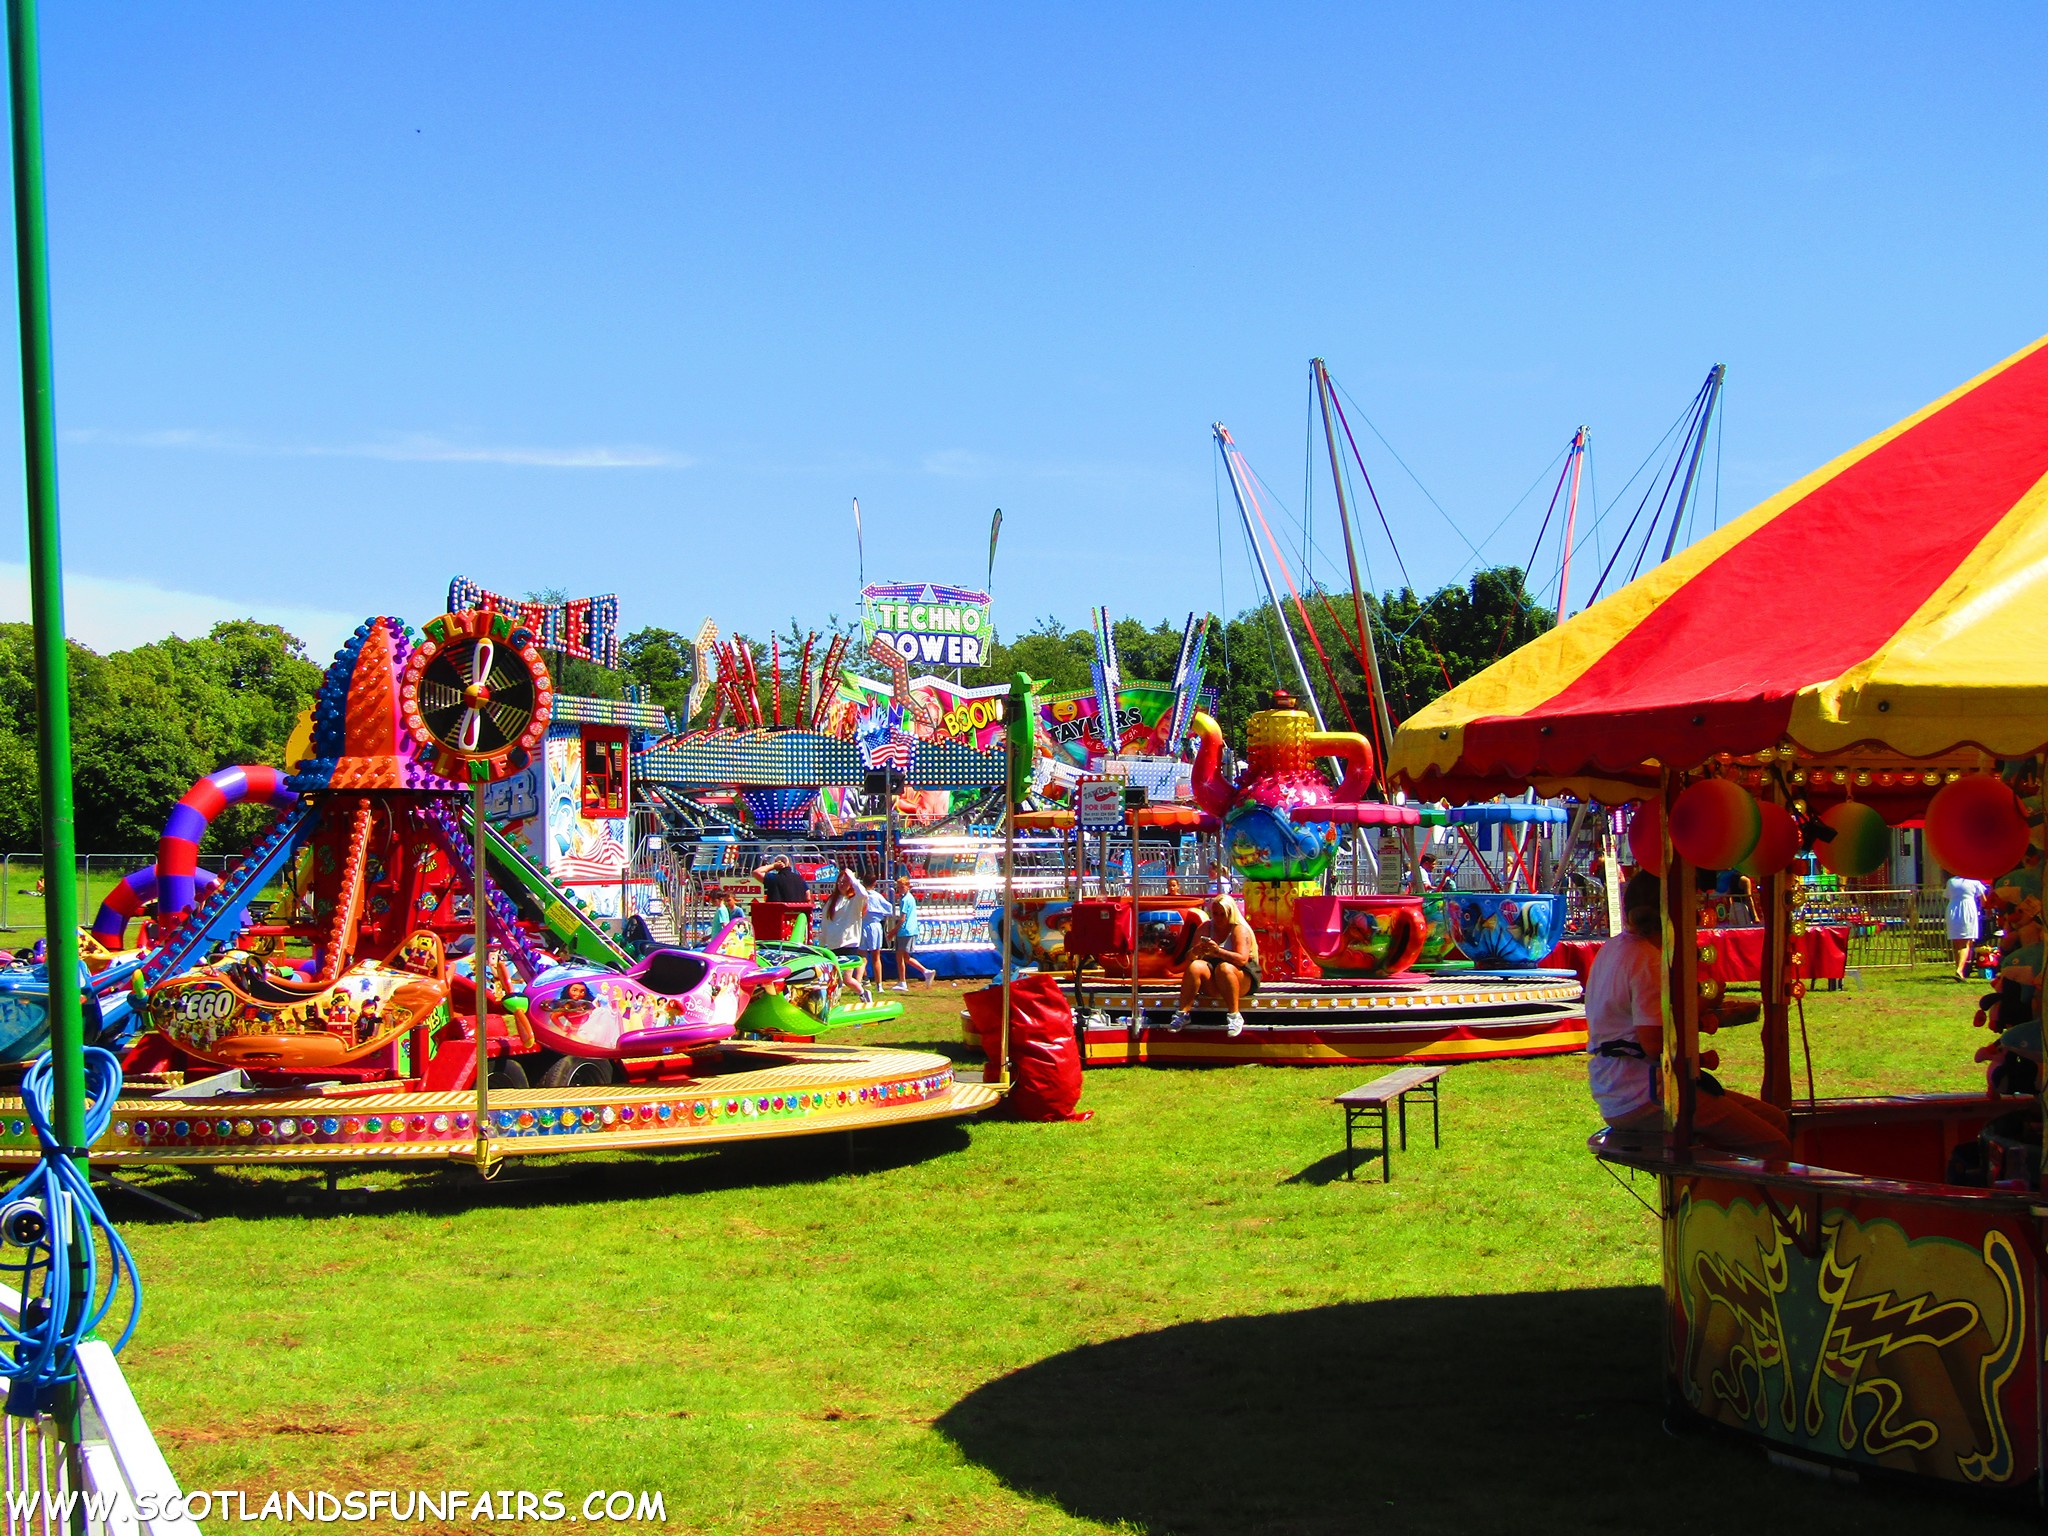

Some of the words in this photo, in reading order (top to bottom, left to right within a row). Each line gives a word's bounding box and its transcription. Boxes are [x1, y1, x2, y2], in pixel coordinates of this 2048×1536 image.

[428, 608, 535, 649] FLYING
[879, 604, 981, 632] TECHNO
[177, 991, 234, 1021] LEGO
